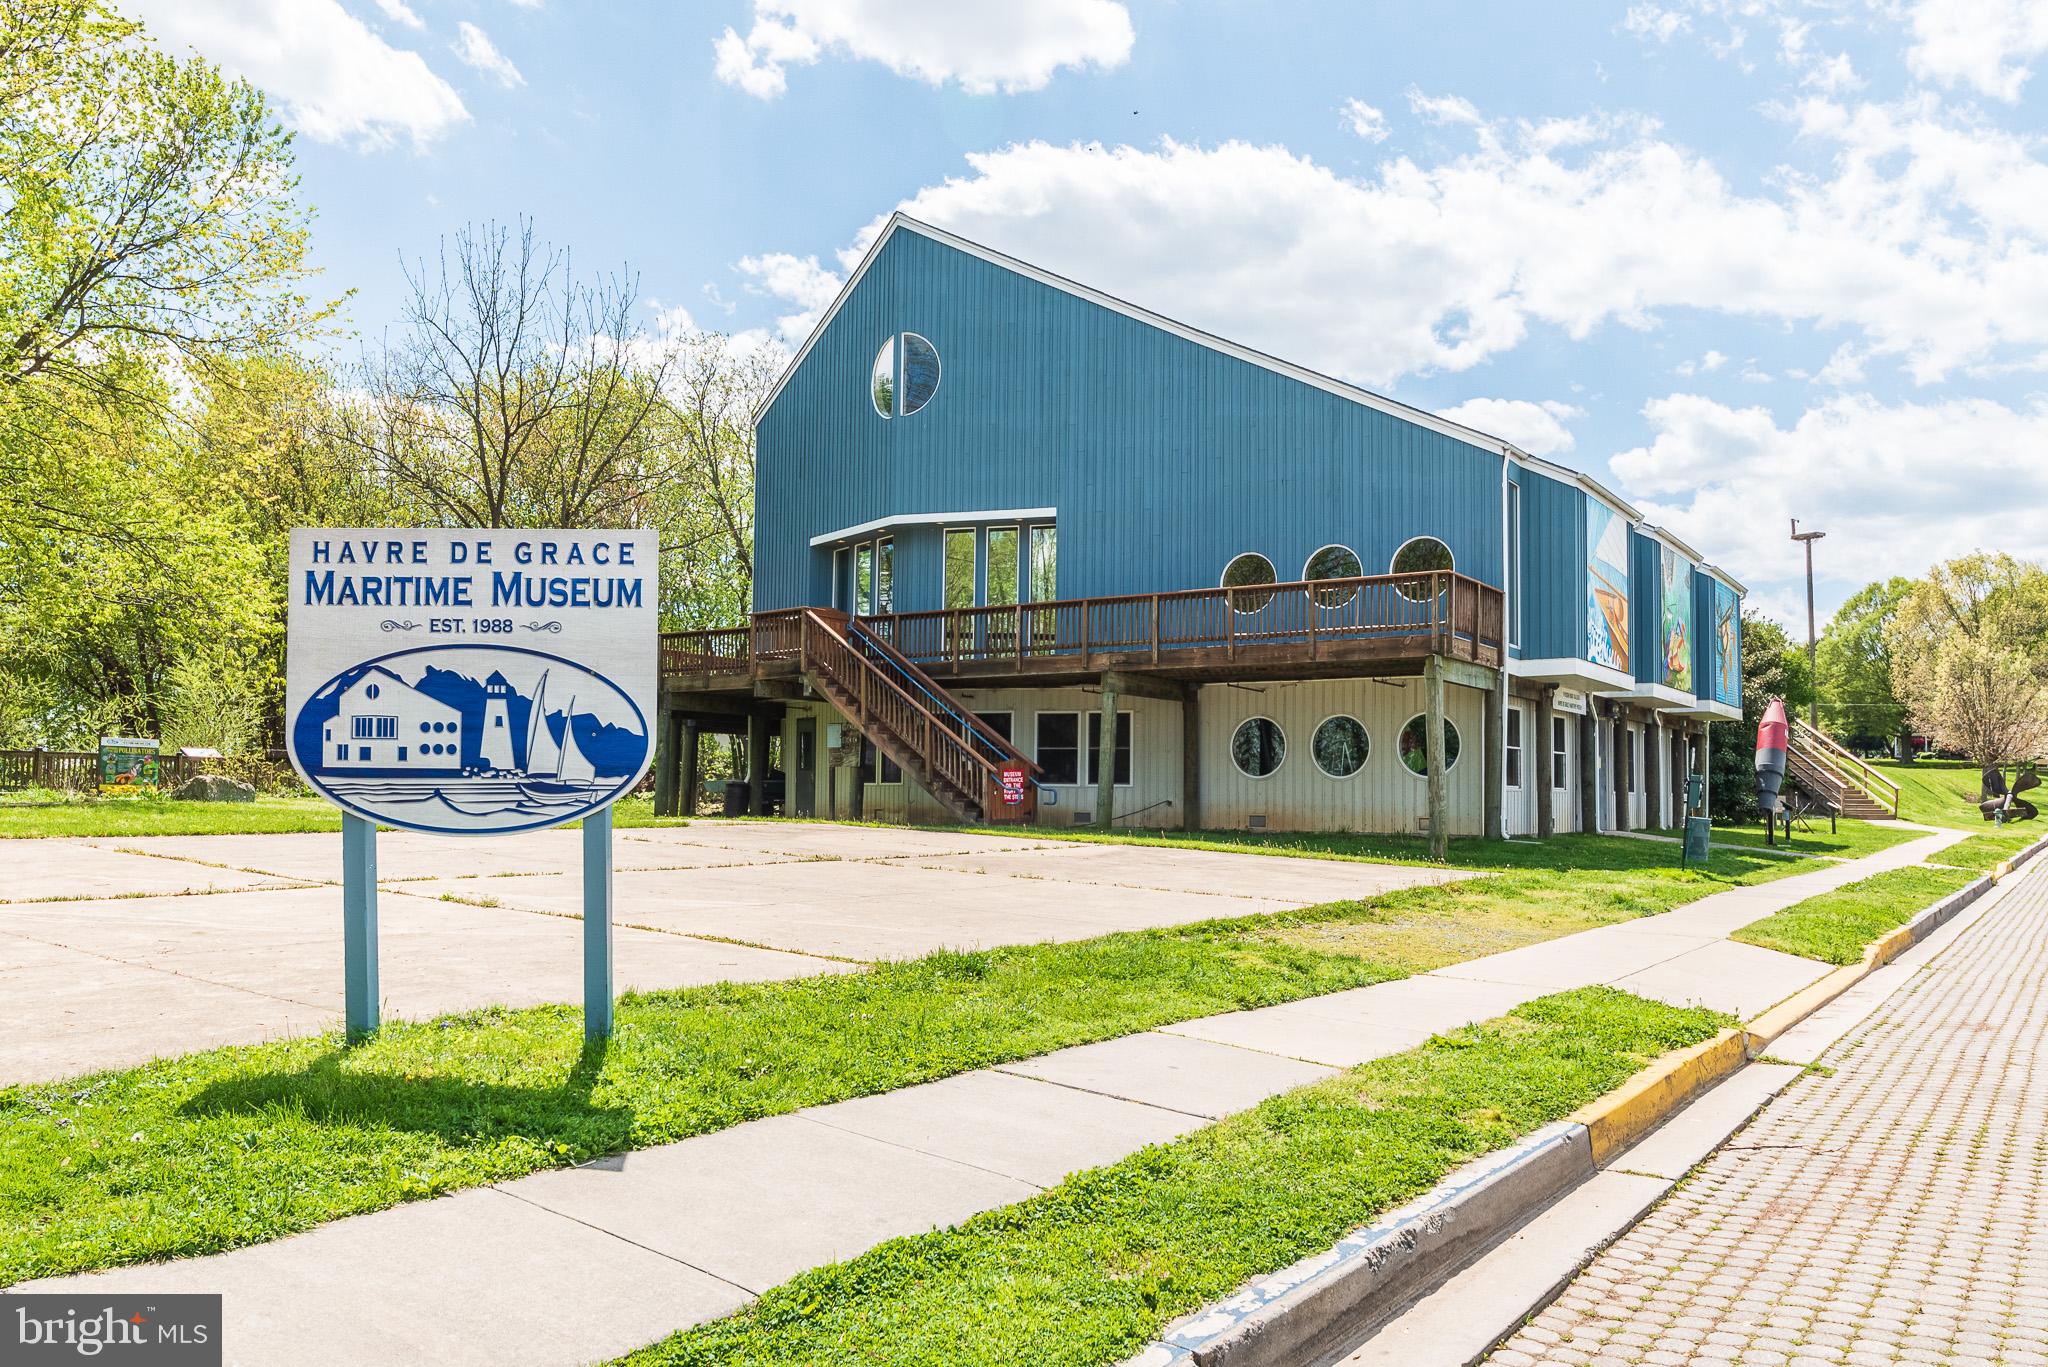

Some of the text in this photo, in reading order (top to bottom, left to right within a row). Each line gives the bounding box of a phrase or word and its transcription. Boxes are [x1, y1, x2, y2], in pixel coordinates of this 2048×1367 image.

[312, 541, 635, 566] HAVRE DE GRACE
[304, 570, 642, 609] MARITIME MUSEUM
[430, 618, 513, 634] EST. 1988
